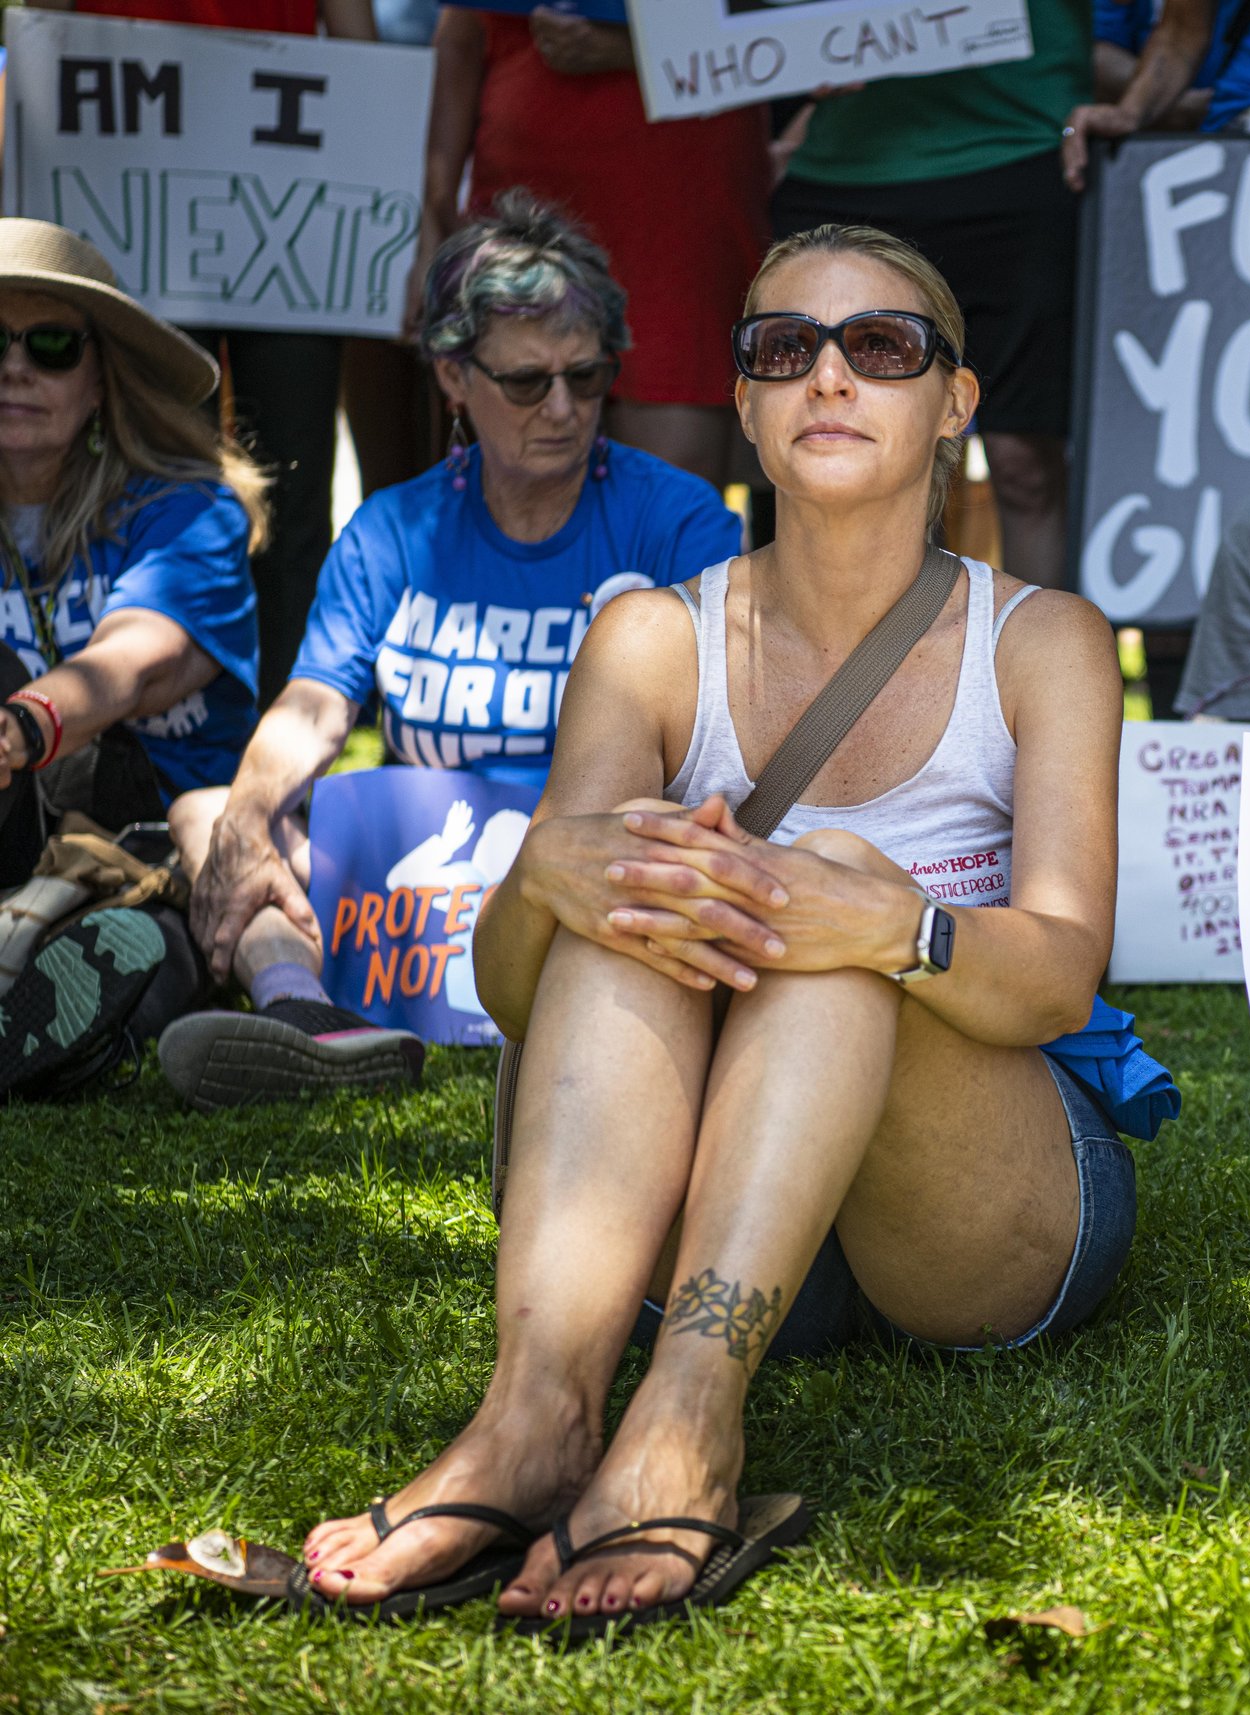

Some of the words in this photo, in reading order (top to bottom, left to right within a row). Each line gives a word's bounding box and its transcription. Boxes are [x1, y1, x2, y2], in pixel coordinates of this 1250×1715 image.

[663, 37, 786, 99] WHO
[821, 5, 971, 66] CAN'T
[58, 55, 182, 136] AM
[251, 69, 327, 149] I
[52, 165, 421, 318] NEXT?
[375, 645, 497, 728] FOR
[1164, 826, 1239, 849] SENA
[1168, 799, 1230, 824] NRA
[904, 859, 949, 877] dness
[950, 850, 999, 873] HOPE
[970, 873, 1005, 893] Peace
[361, 942, 466, 1010] NOT
